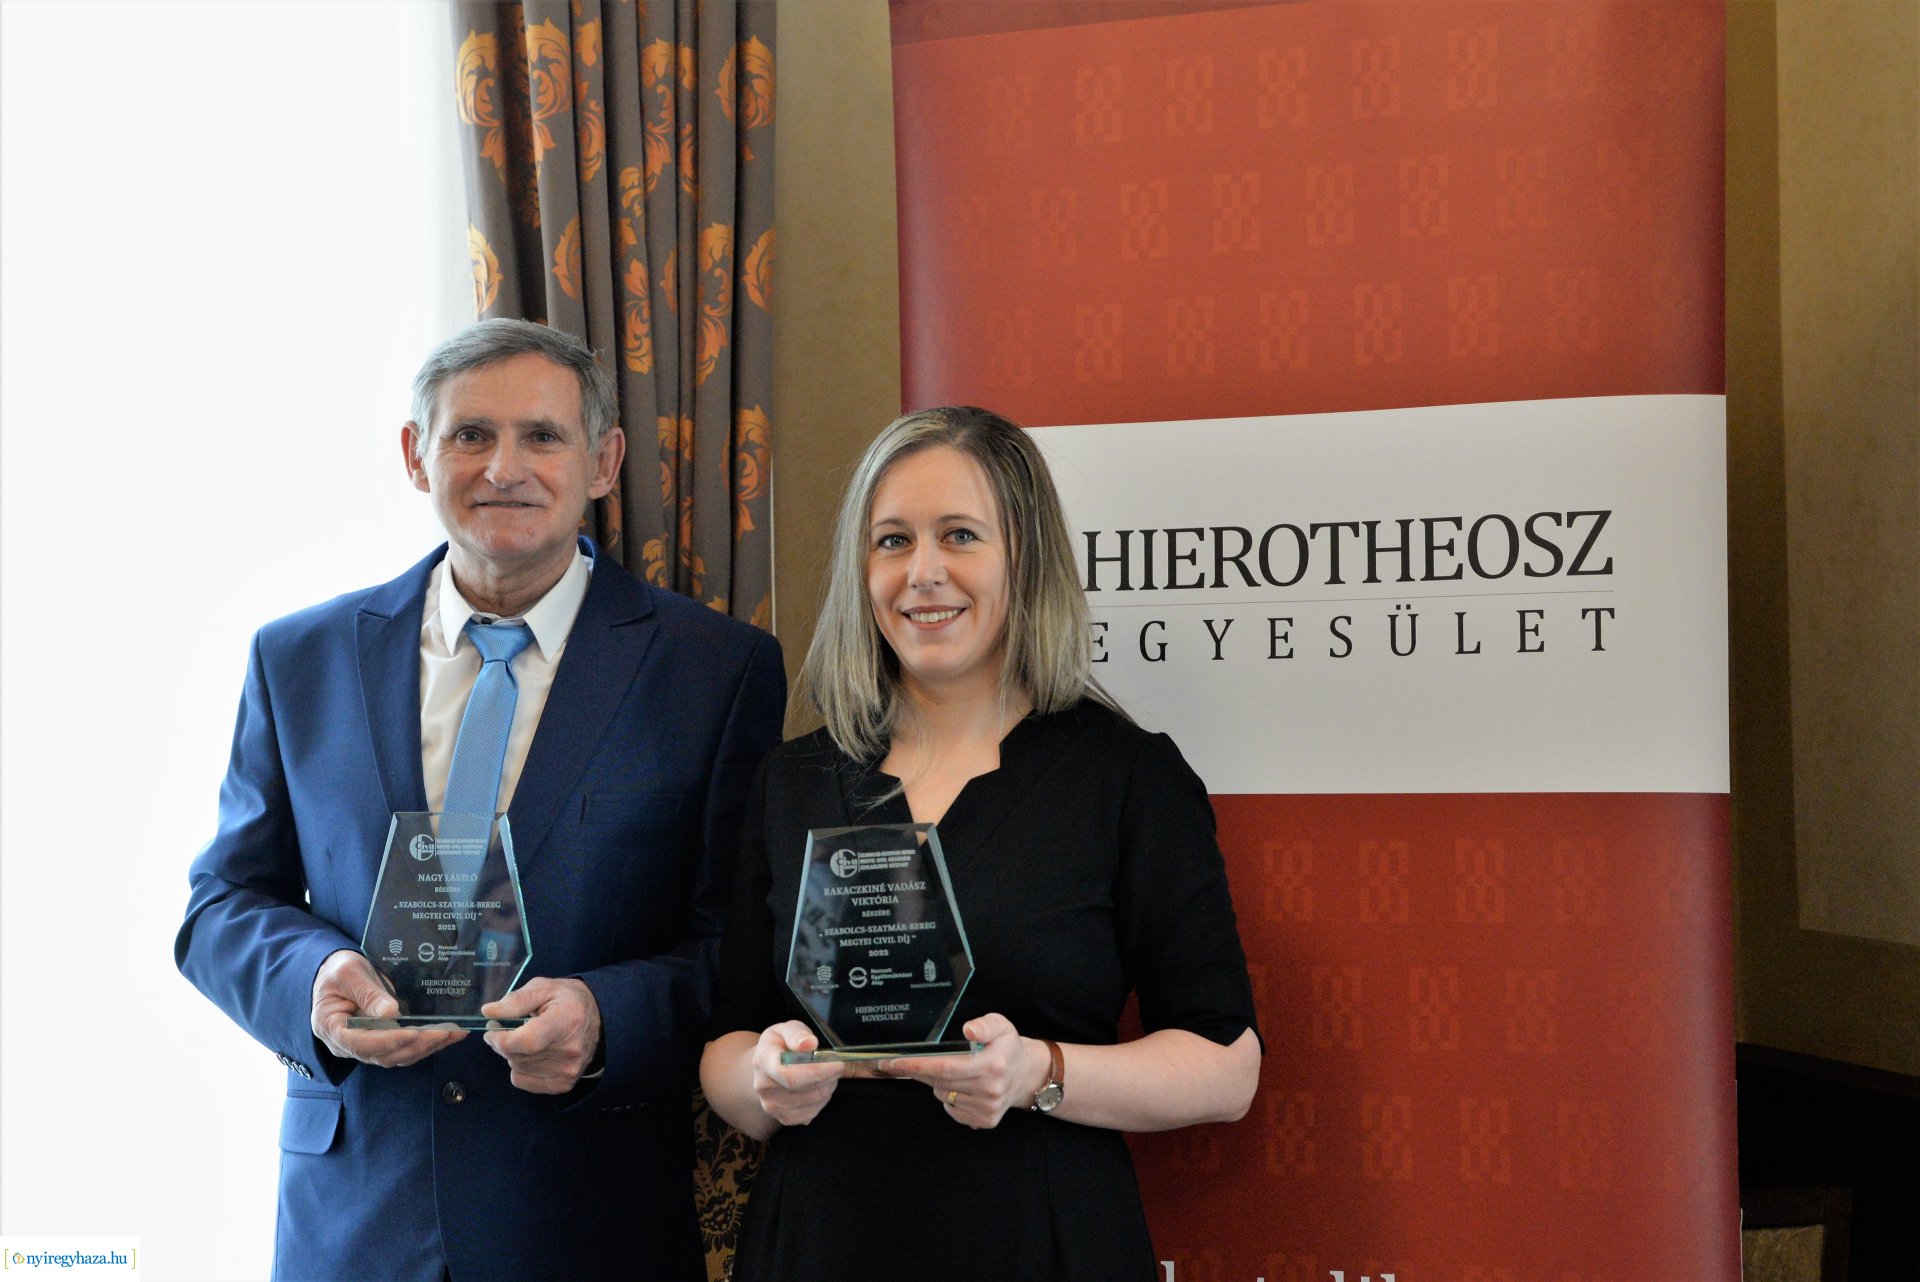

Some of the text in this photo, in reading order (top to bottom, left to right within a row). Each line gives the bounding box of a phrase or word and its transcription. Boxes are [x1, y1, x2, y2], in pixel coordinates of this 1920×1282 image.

[1082, 510, 1614, 592] HIEROTHEOSZ
[1091, 604, 1615, 663] EGYESÜLET
[418, 872, 478, 882] NAGY LÁSZLÓ
[824, 882, 926, 896] RAKACZKINÉ VADÁSZ
[399, 901, 501, 909] SZABOLCS-SZATMÁR-BEREG
[852, 896, 899, 906] VIKTÓRIA
[412, 912, 442, 920] MEGYEI
[443, 912, 462, 920] CIVIL
[465, 911, 477, 921] DÍJ
[824, 922, 936, 936] SZABOLCS-SZATMÁR-BEREG
[840, 938, 872, 947] MEGYEI
[873, 936, 896, 946] CIVIL
[897, 934, 911, 945] DÍJ
[868, 949, 889, 957] 2022
[421, 979, 472, 987] HIEROTHEOSZ
[426, 987, 466, 995] EGYESÜLET
[856, 1004, 910, 1013] HIEROTHEOSZ
[862, 1013, 904, 1022] EGYESÜLET
